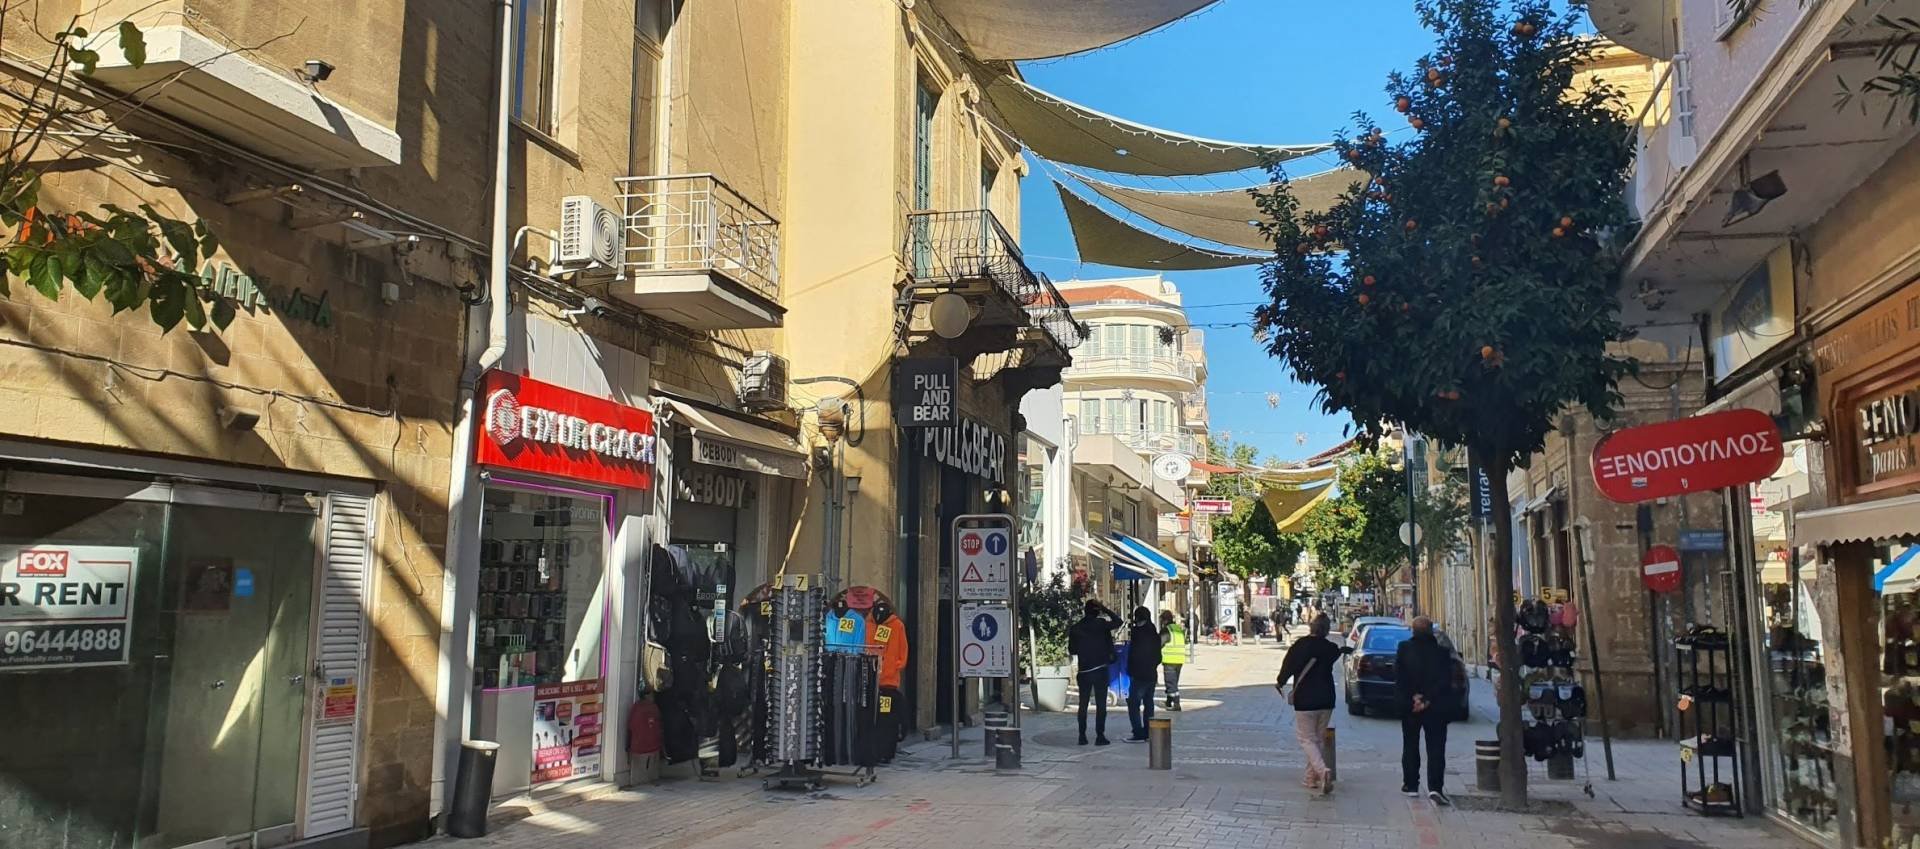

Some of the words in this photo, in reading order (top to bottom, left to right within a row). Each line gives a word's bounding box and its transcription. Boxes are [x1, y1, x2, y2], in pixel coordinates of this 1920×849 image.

[914, 373, 950, 390] PULL
[921, 390, 950, 406] AND
[913, 405, 950, 421] BEAR
[520, 405, 558, 444] FIX
[557, 413, 590, 451] UR
[589, 421, 656, 465] CRACK
[699, 440, 738, 464] ICEBODY
[1600, 431, 1774, 478] ΞΕΝΟΠΟΥΛΛΟΣ
[963, 538, 980, 550] STOP
[20, 552, 66, 571] FOX
[797, 576, 805, 588] 7
[34, 582, 124, 606] RENT
[1543, 588, 1551, 600] 5
[841, 619, 854, 630] 28
[4, 628, 121, 655] 96444888
[877, 627, 890, 640] 28
[880, 697, 890, 708] 28
